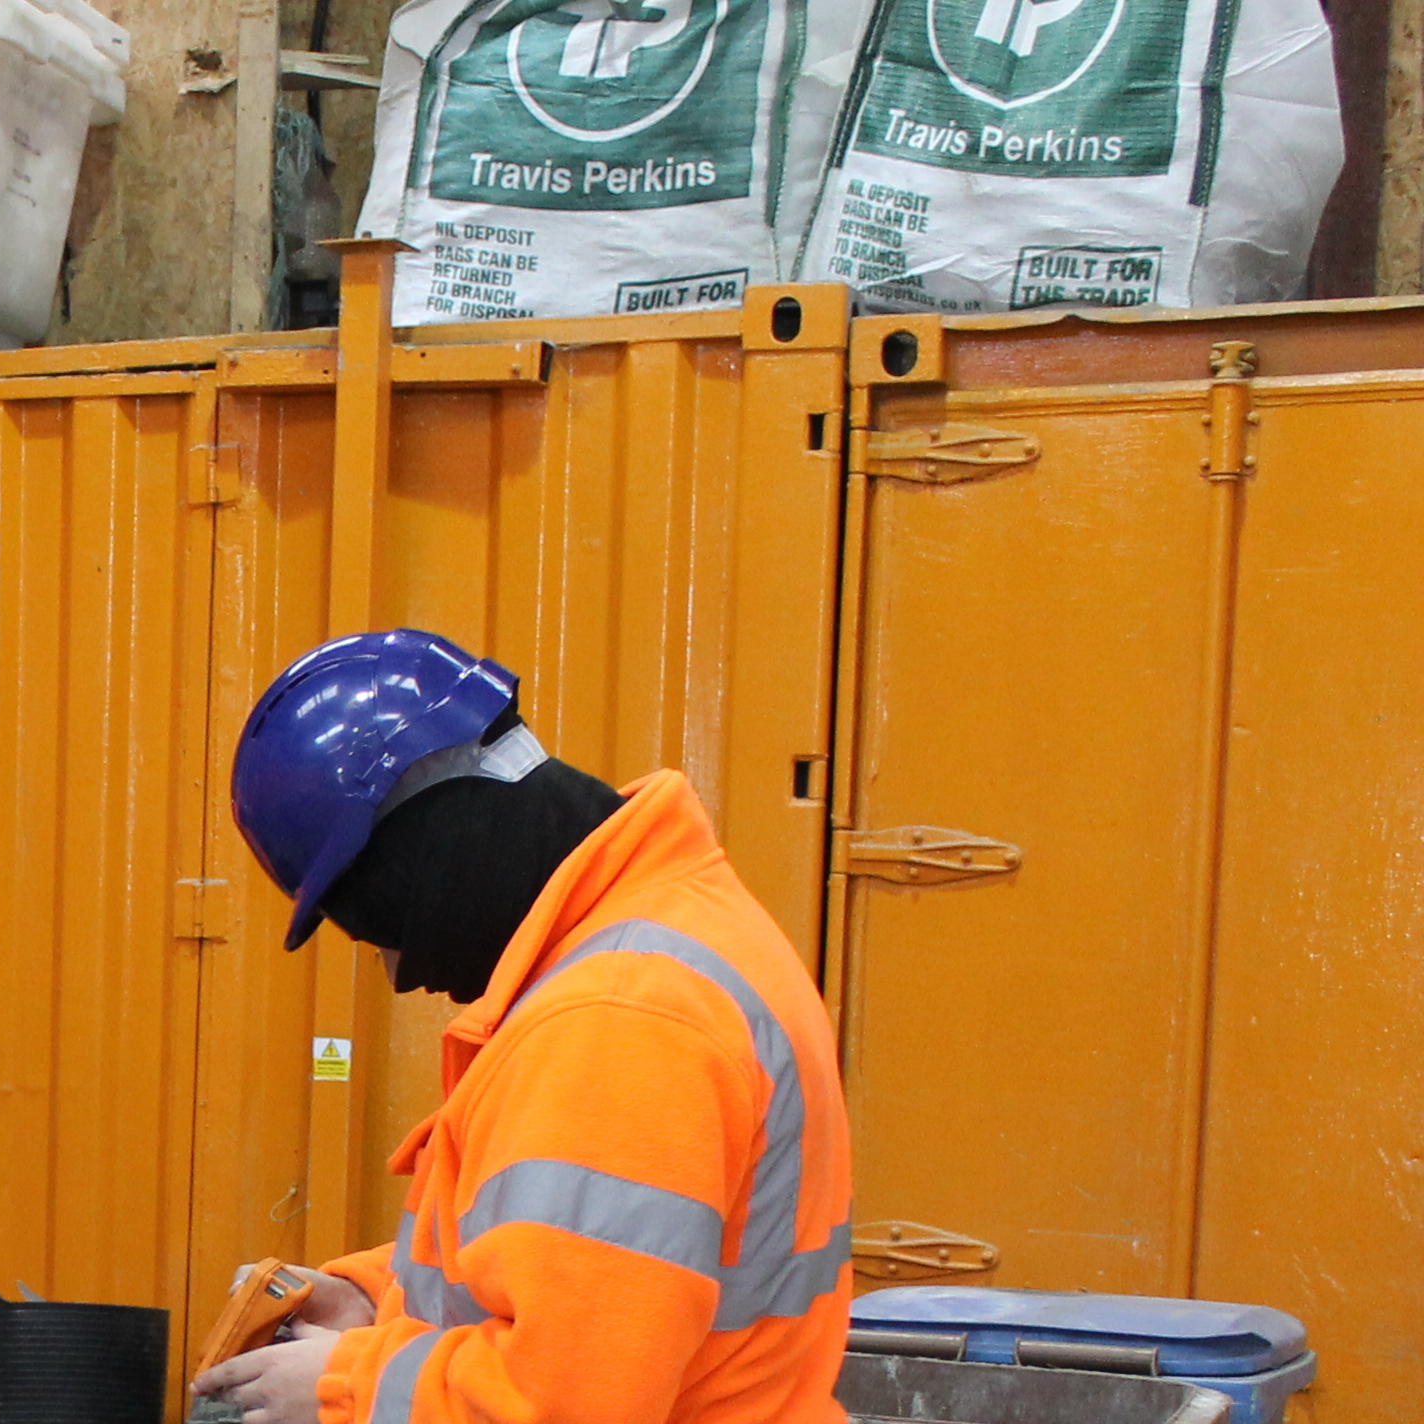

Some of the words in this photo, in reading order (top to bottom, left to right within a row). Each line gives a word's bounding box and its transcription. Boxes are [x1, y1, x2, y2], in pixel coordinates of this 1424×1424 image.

[884, 108, 969, 155] Travis
[979, 125, 1123, 162] Perkins
[470, 152, 572, 194] Travis
[583, 157, 716, 194] Perkins
[868, 183, 932, 213] DEPOSIT
[843, 200, 872, 221] BAGS
[875, 207, 904, 228] CAN
[907, 214, 929, 234] BE
[435, 221, 458, 238] NIL
[464, 223, 535, 246] DEPOSIT
[838, 219, 902, 248] RETURNED
[435, 245, 475, 264] BAGS
[478, 249, 513, 268] CAN
[516, 254, 538, 272] BE
[835, 237, 851, 255] TO
[851, 241, 906, 269] BRANCH
[433, 262, 513, 287] RETURNED
[828, 256, 852, 278] FOR
[1029, 256, 1099, 280] BUILT
[1106, 257, 1154, 282] FOR
[426, 295, 454, 314] FOR
[430, 279, 449, 296] TO
[451, 281, 516, 306] BRANCH
[626, 287, 688, 312] BUILT
[696, 281, 737, 303] FOR
[1021, 285, 1066, 302] THE
[1076, 287, 1151, 307] TRADE
